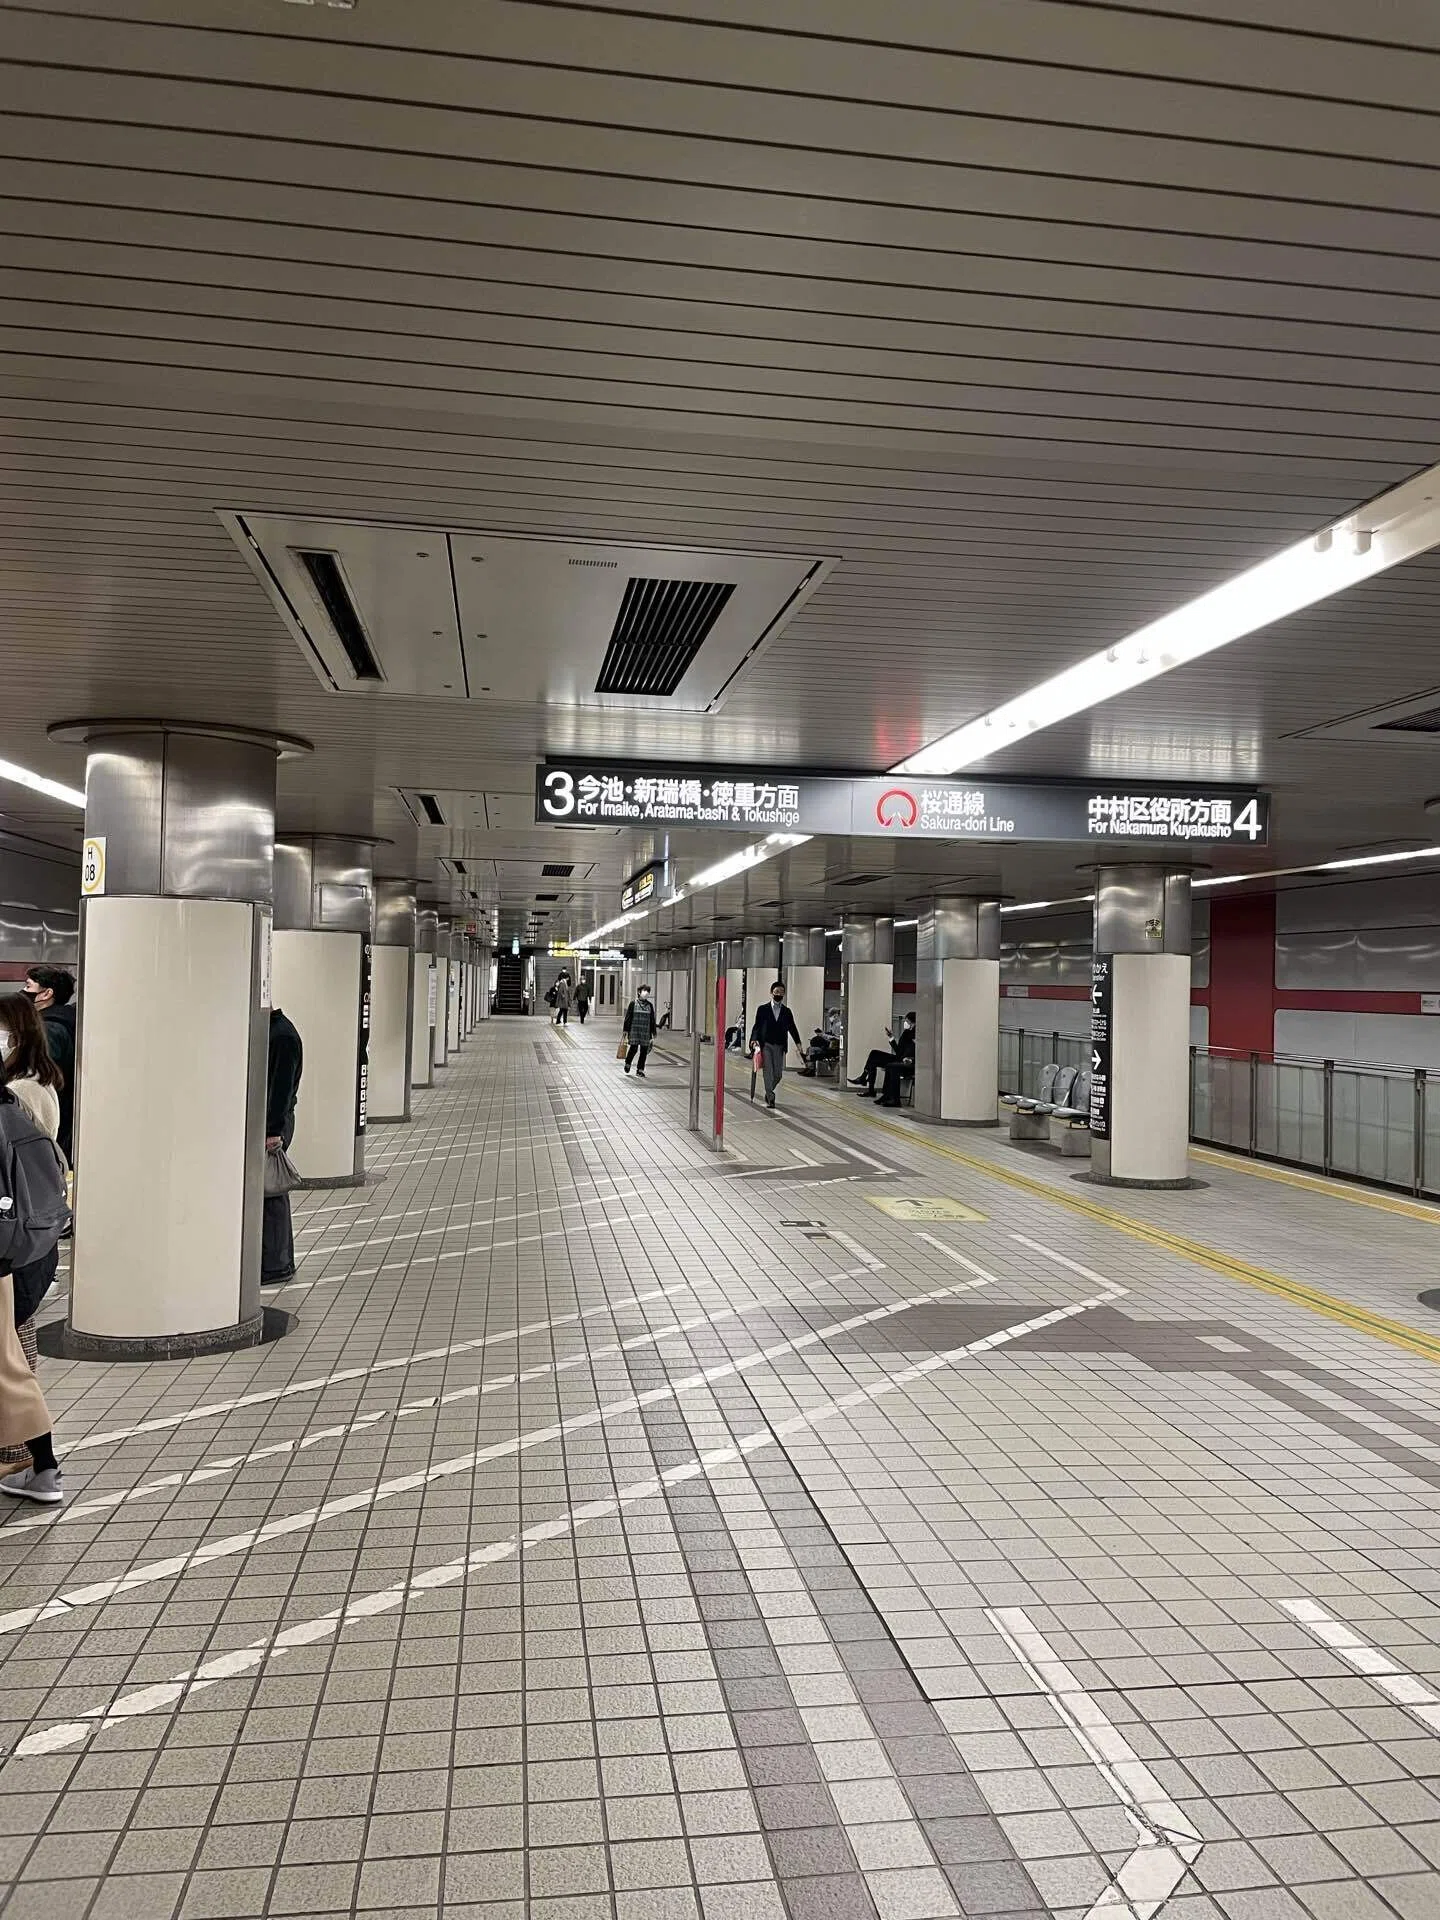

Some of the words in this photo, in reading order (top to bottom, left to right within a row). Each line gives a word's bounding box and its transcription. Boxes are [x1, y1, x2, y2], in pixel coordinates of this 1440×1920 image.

[544, 771, 575, 816] 3
[921, 790, 985, 816] 桜通線
[577, 799, 599, 815] For
[600, 801, 643, 819] Imaike,
[644, 802, 729, 821] Aratama-bashi
[731, 806, 740, 821] &
[742, 806, 800, 827] Tokushige
[920, 815, 988, 832] Sakura-dori
[989, 817, 1015, 832] Line
[1088, 796, 1232, 824] 中村区役所方面
[1233, 799, 1262, 840] 4
[1088, 818, 1109, 833] For
[1110, 819, 1168, 835] Nakamura
[1170, 820, 1232, 839] Kuyakusho
[87, 847, 93, 860] H
